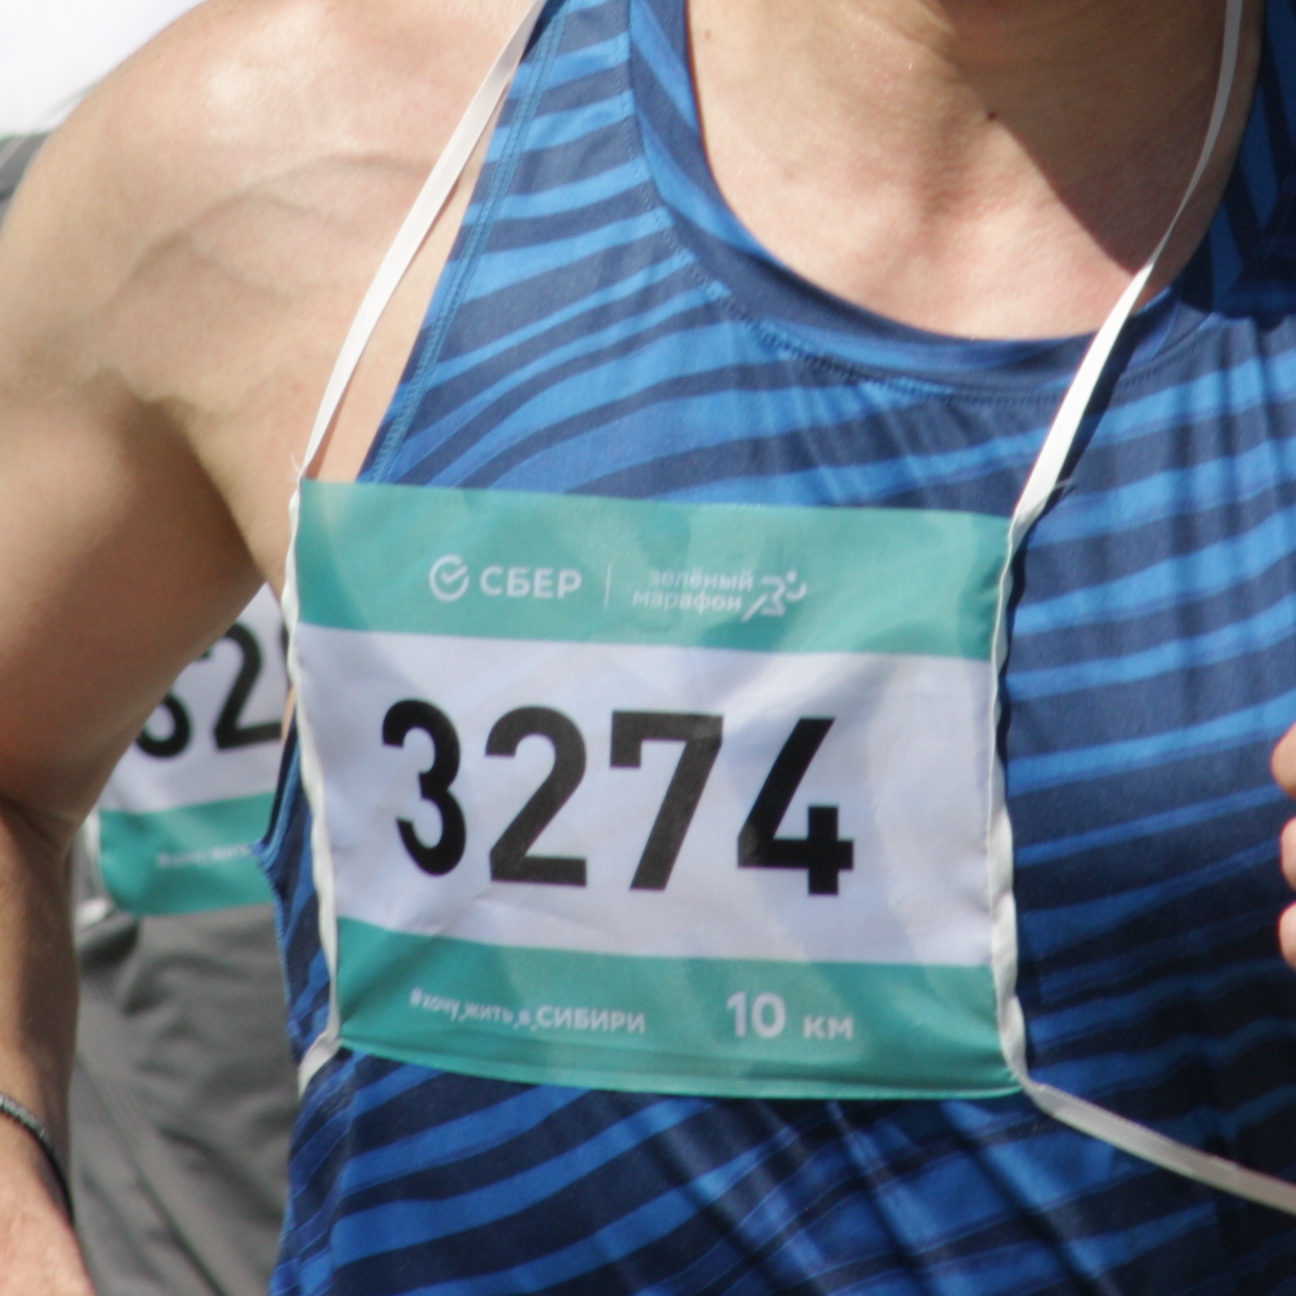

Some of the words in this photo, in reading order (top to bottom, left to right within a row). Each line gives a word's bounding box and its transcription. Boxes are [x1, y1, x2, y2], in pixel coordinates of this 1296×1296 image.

[479, 564, 584, 600] СБЕР
[632, 588, 743, 615] марафон
[381, 698, 855, 896] 3274
[726, 990, 787, 1039] 10
